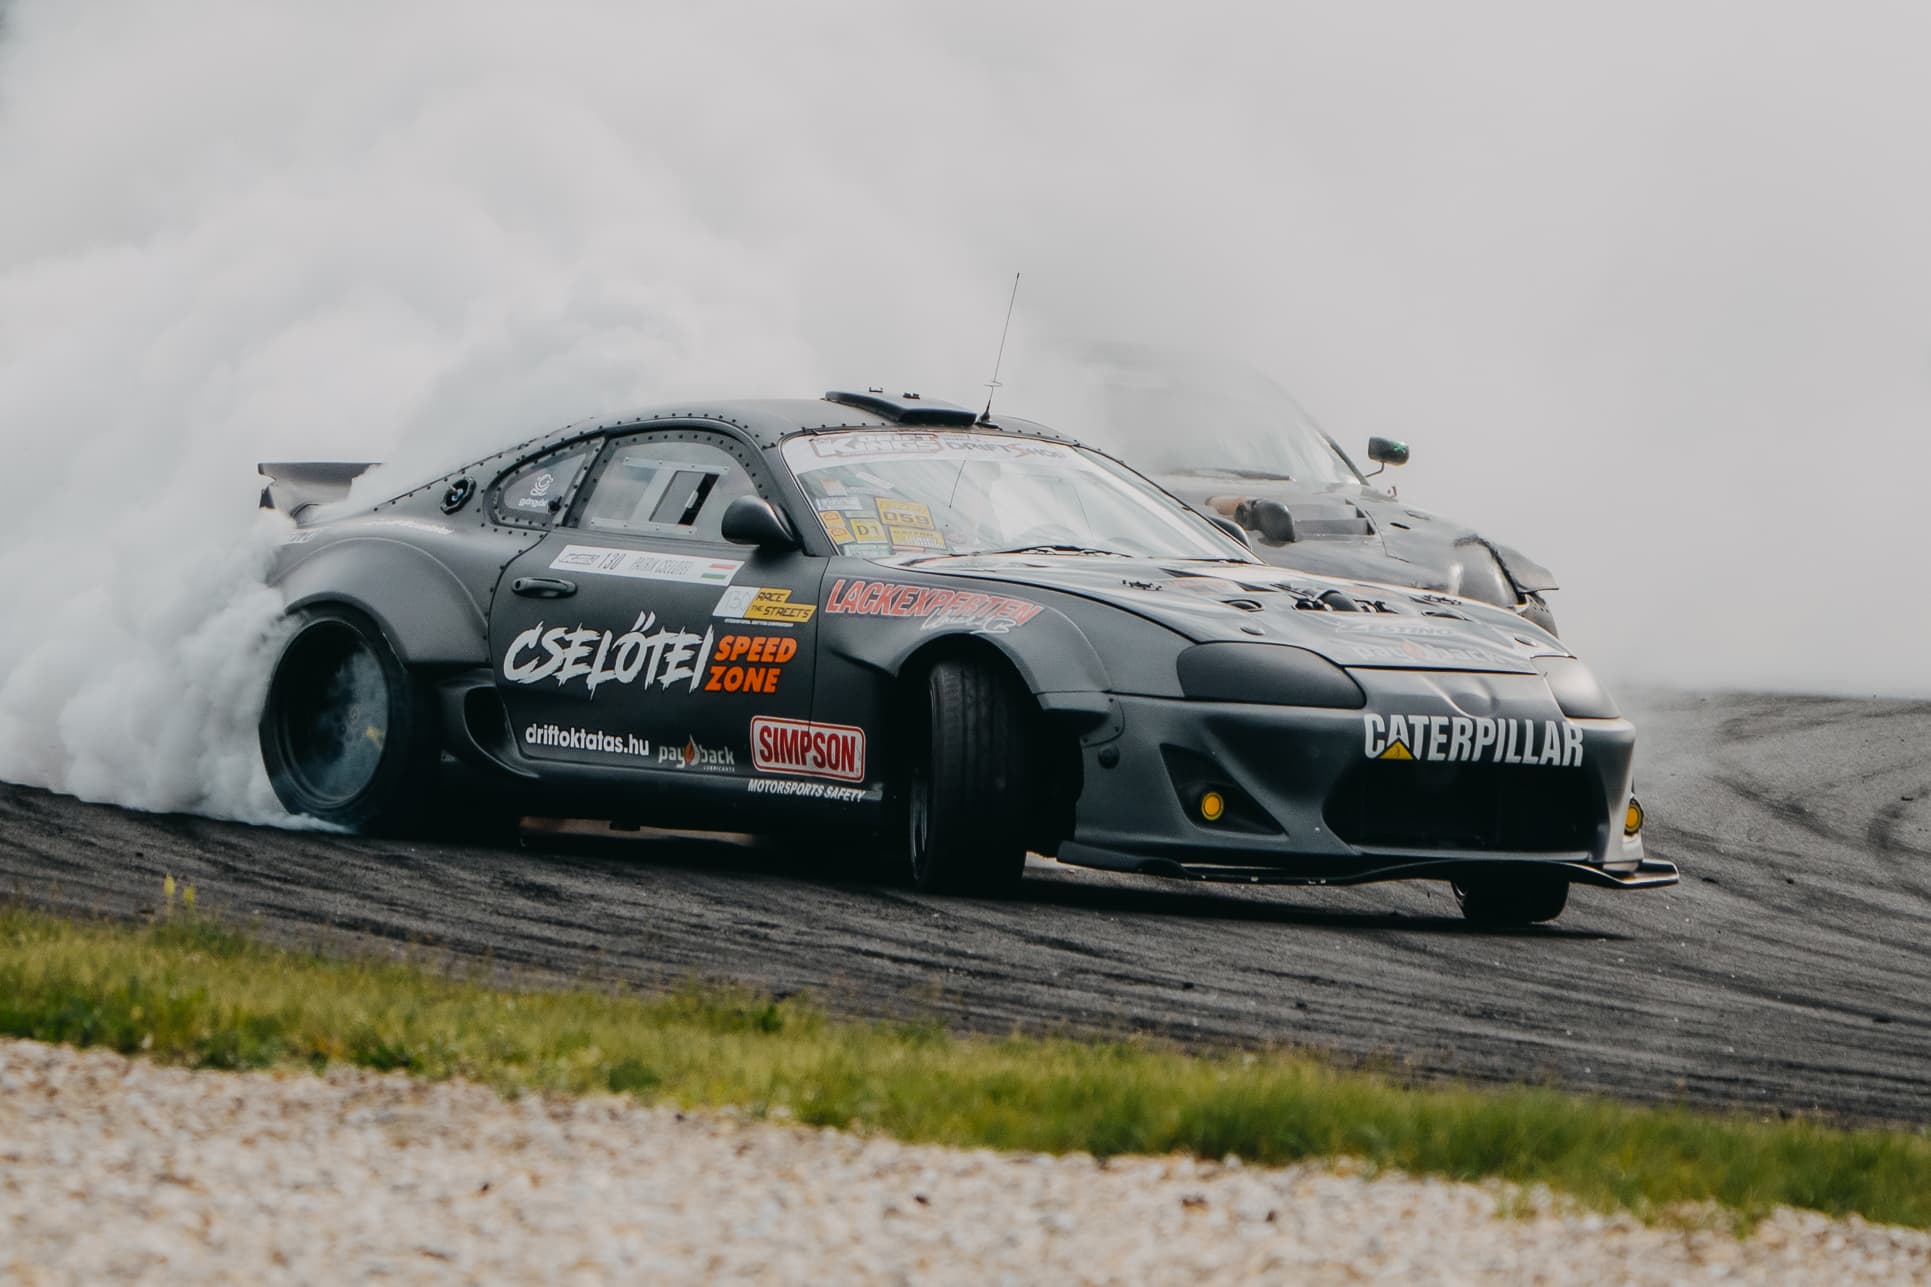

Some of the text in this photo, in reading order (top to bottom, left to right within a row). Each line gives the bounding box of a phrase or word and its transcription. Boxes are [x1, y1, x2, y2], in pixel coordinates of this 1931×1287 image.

[756, 591, 786, 603] RACE
[764, 606, 813, 618] STREETS
[825, 578, 1045, 626] LACKEXPERTEN
[503, 610, 715, 700] CSELŐTEI
[714, 634, 798, 664] SPEED
[704, 667, 783, 695] ZONE
[525, 723, 650, 758] driftoktatas.hu
[759, 724, 856, 773] SIMPSON
[1363, 713, 1584, 768] CATERPILLAR
[748, 779, 866, 803] MOTORSPORTS SAFETY
